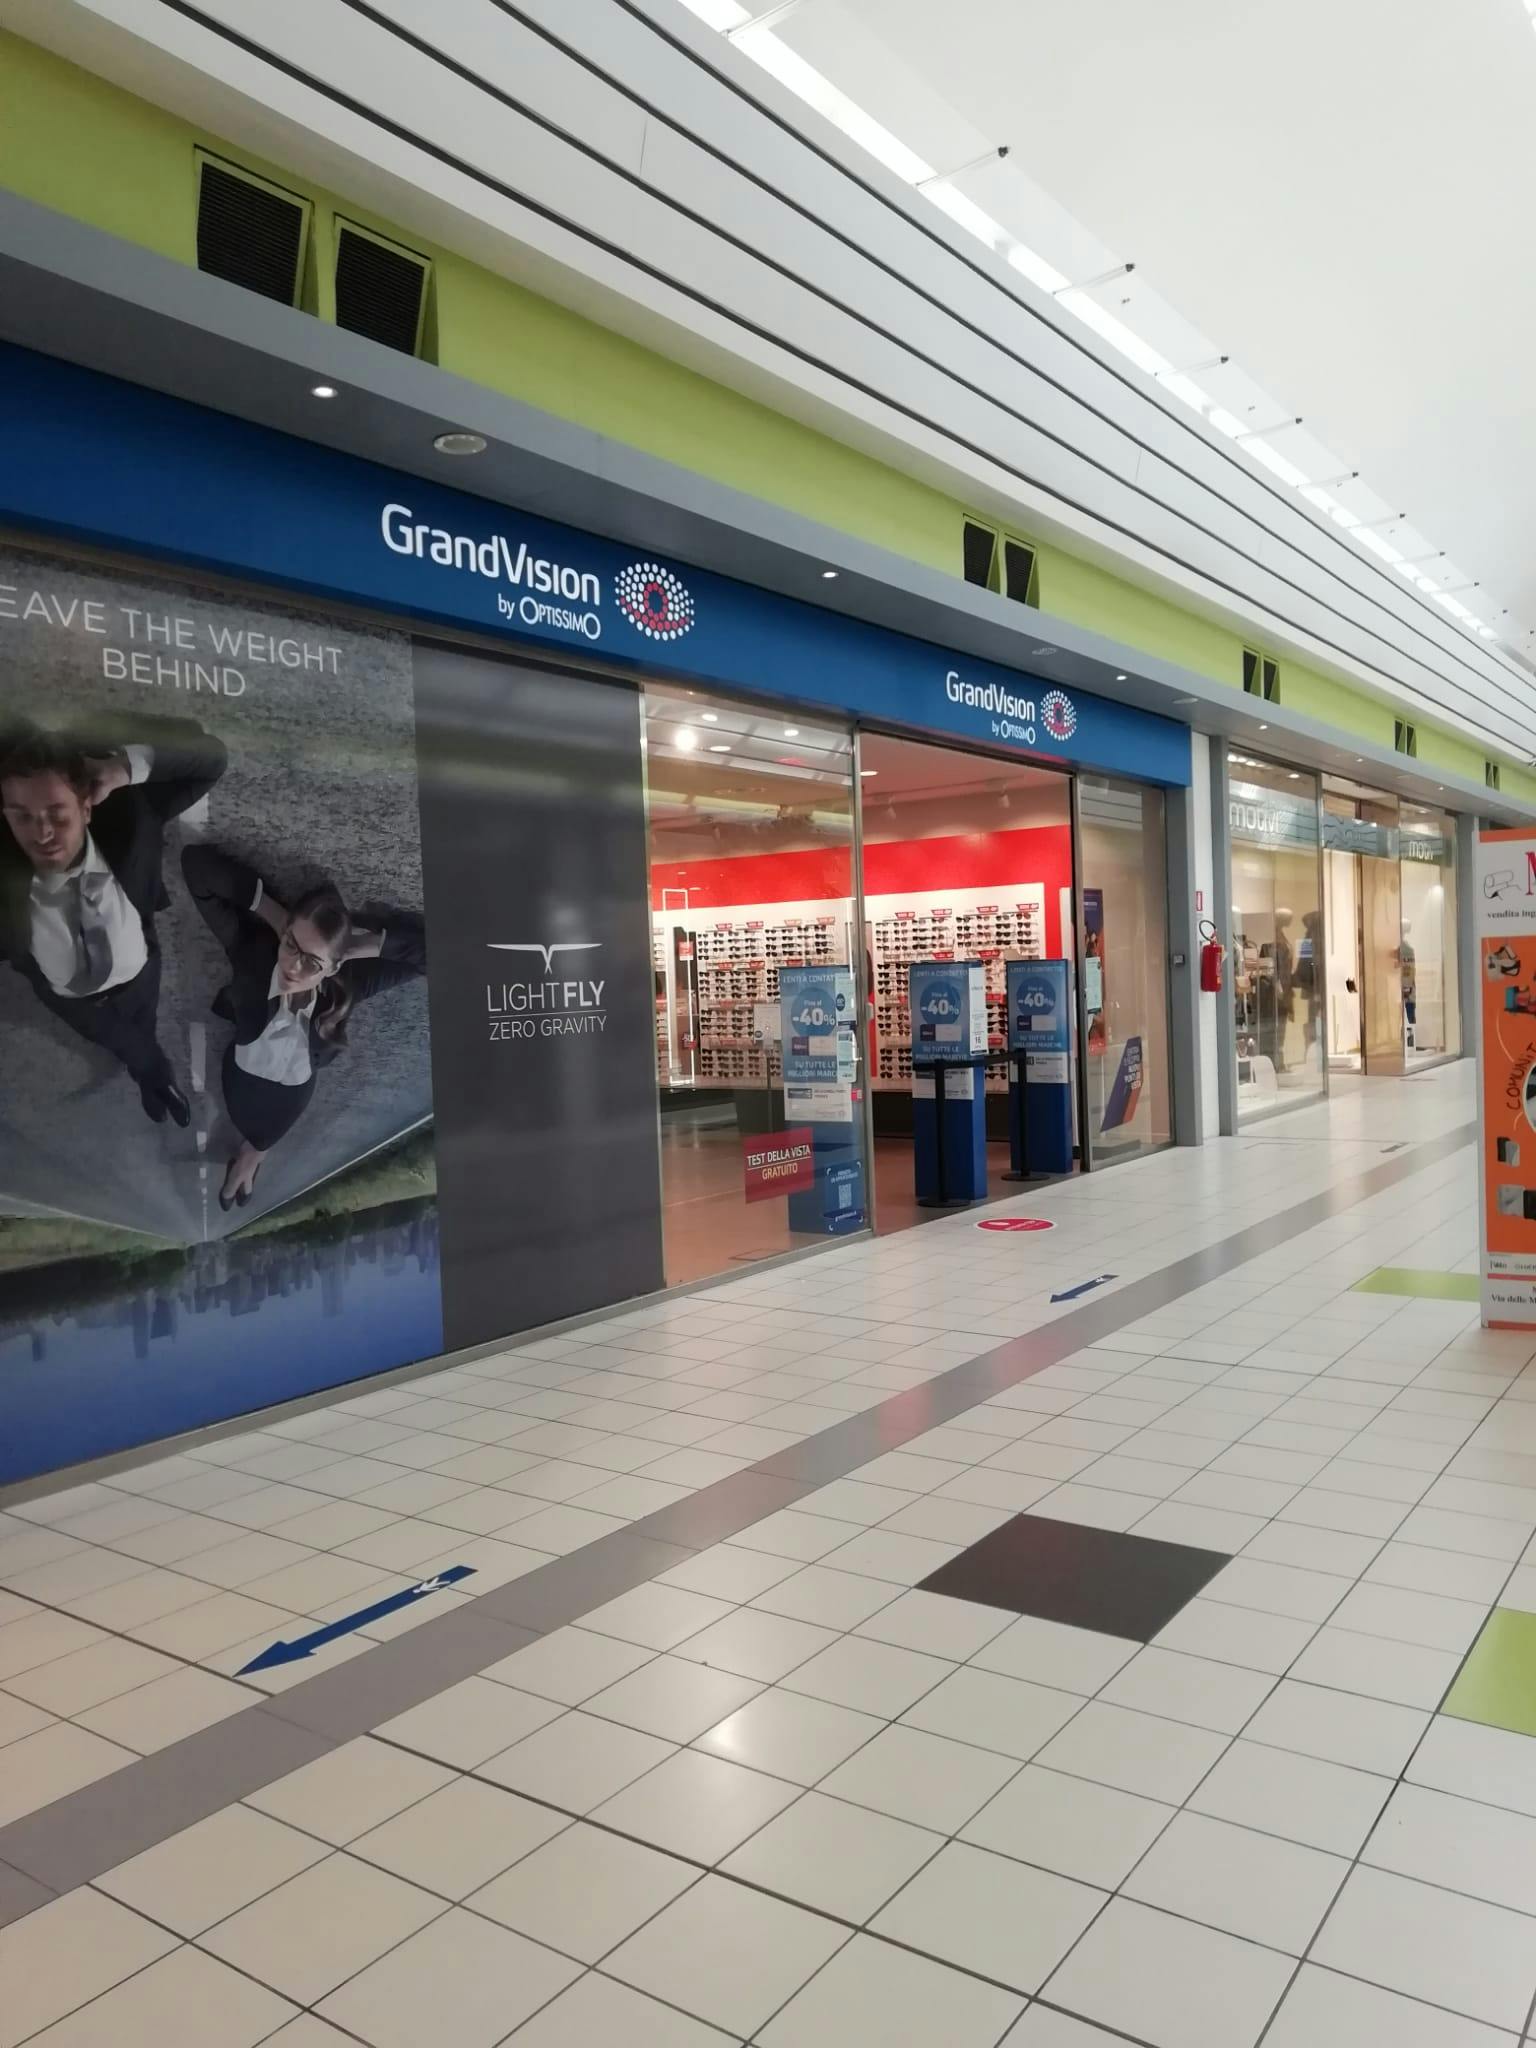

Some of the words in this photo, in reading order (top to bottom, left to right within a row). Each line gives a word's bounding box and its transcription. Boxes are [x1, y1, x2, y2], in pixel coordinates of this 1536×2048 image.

[381, 503, 600, 606] GrandVision
[498, 593, 516, 620] by
[519, 596, 601, 641] OPTISSIMO
[120, 607, 195, 650] THE
[208, 624, 342, 675] WEIGHT
[102, 647, 247, 697] BEHIND
[946, 671, 1035, 722] GrandVision
[992, 720, 999, 736] by
[1487, 909, 1519, 919] vendita
[793, 1008, 836, 1026] -40%
[921, 999, 959, 1015] -40%
[489, 1020, 536, 1040] ZERO
[541, 1015, 607, 1036] GRAVITY
[747, 1153, 765, 1166] TEST
[767, 1148, 790, 1163] DELLA
[791, 1144, 811, 1158] VISTA
[762, 1162, 798, 1180] GRATUITO
